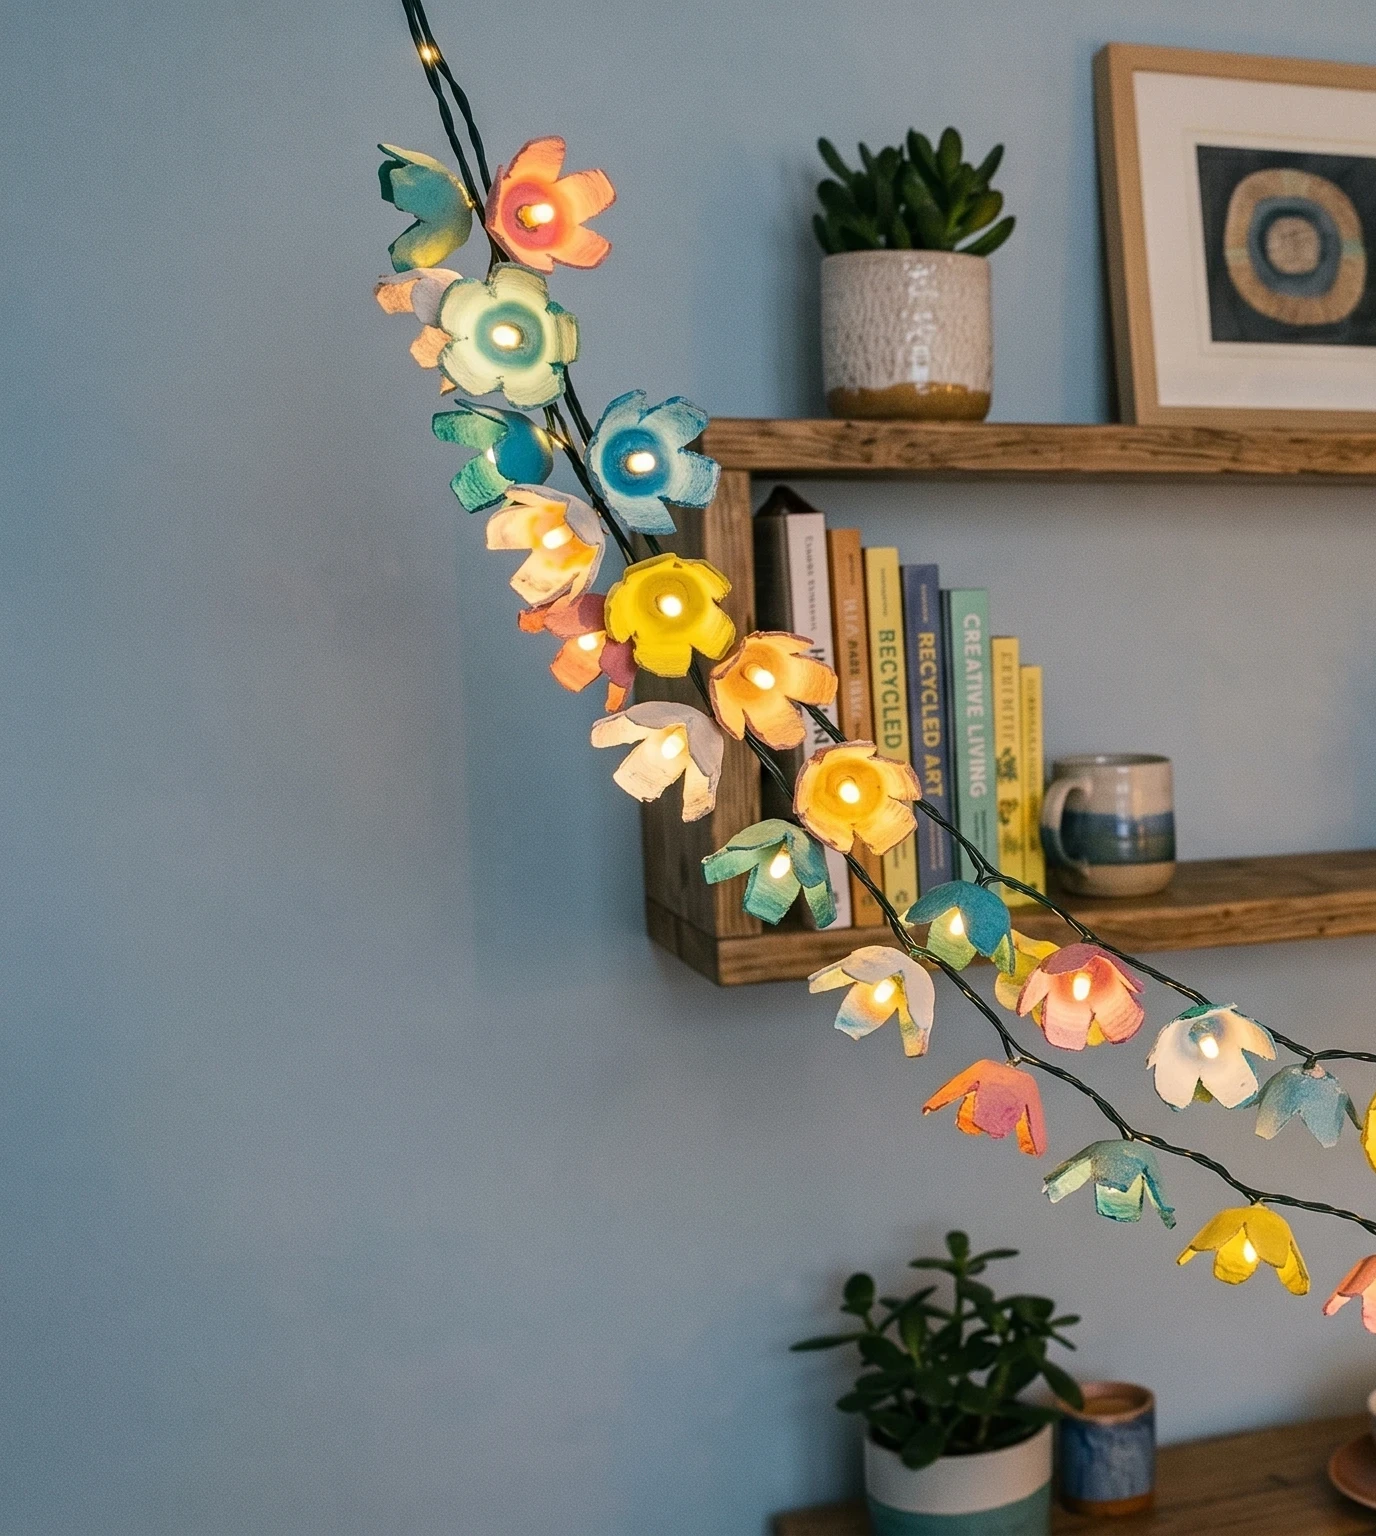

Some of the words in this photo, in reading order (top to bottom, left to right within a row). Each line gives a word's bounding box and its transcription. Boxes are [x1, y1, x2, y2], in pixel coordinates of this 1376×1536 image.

[917, 632, 941, 748] RECYCLED
[963, 613, 985, 718] CREATIVE
[924, 754, 944, 797] ART
[967, 725, 987, 798] LIVING
